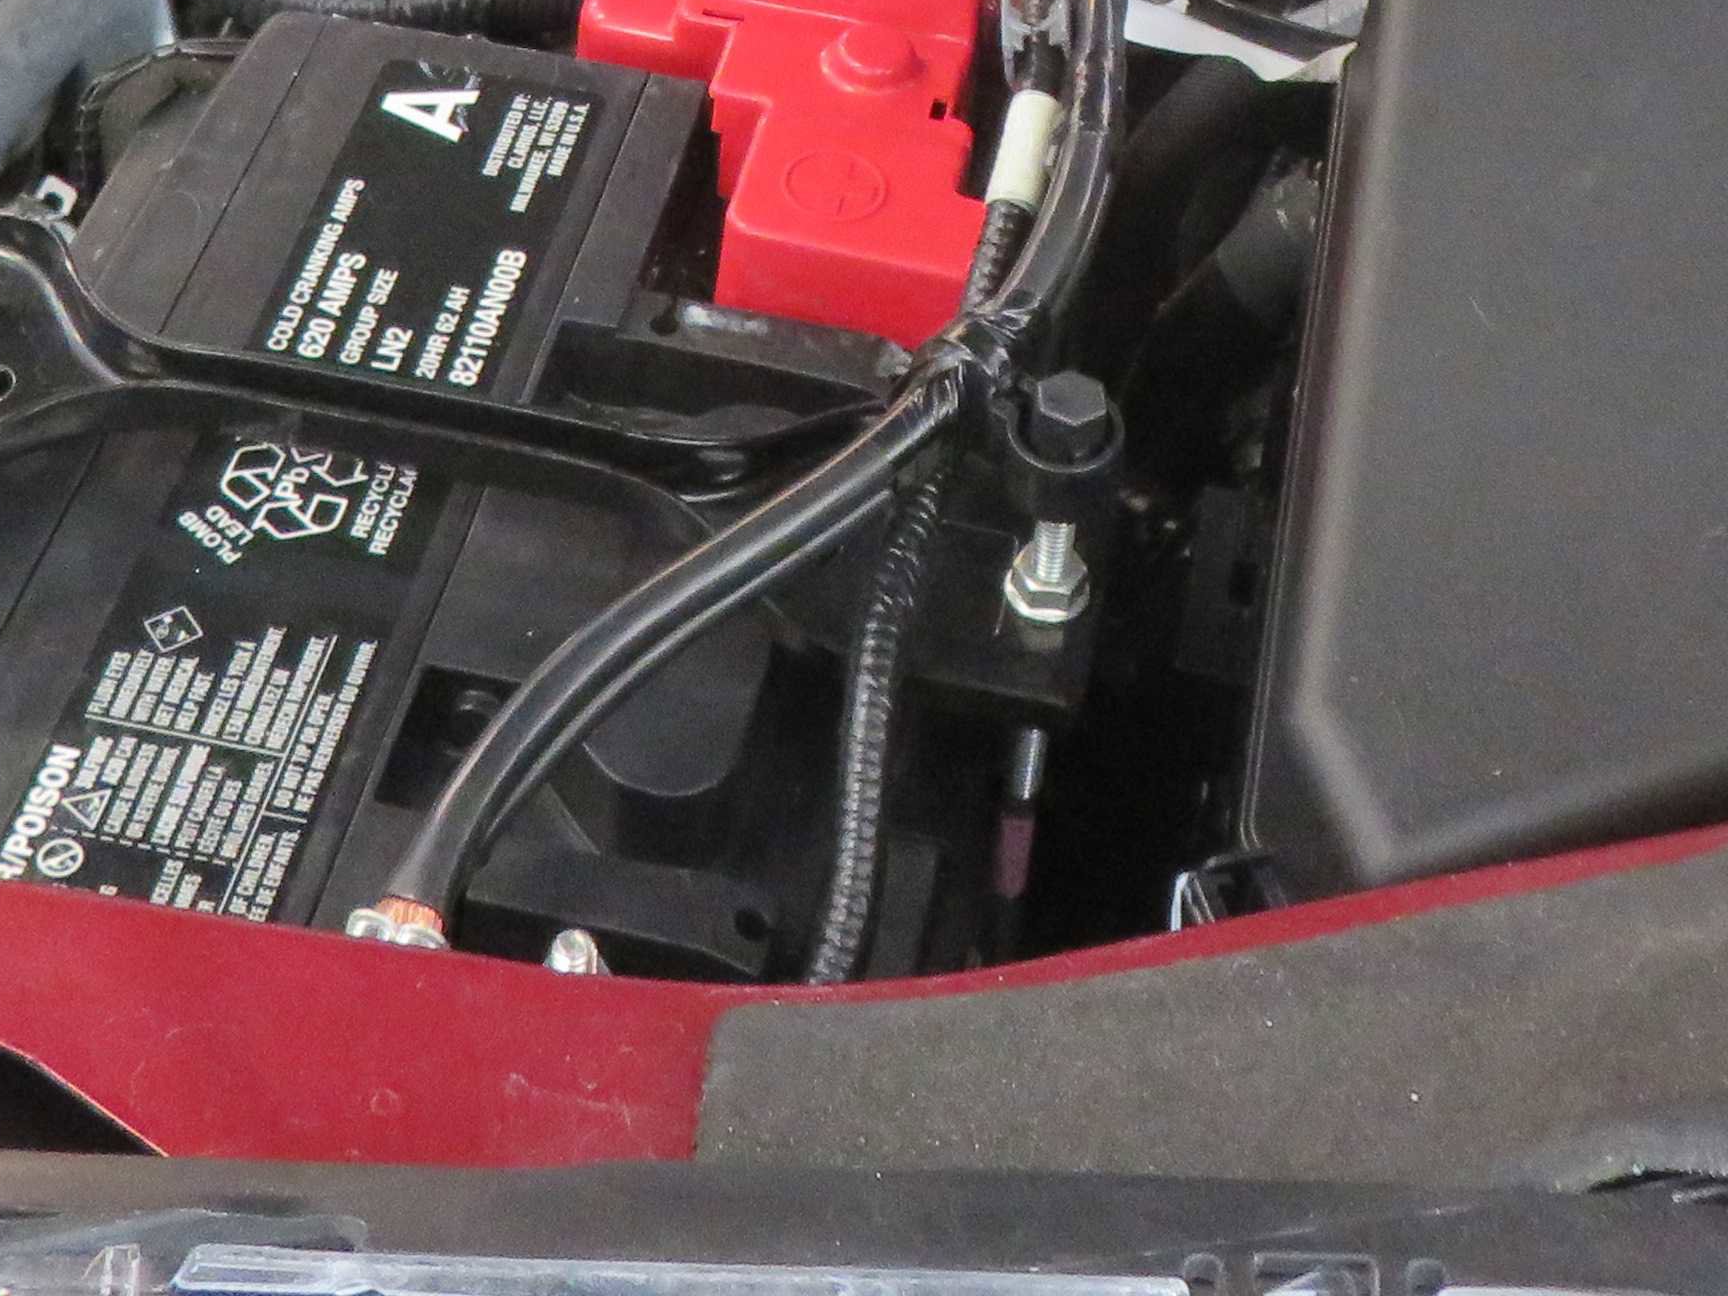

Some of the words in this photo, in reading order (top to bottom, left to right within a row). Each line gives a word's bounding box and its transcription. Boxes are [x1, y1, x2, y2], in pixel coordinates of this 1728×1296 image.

[380, 88, 482, 143] A
[563, 100, 591, 132] U.S.A.
[480, 110, 525, 176] DISTRIBUTED
[510, 92, 532, 110] BY:
[505, 119, 542, 168] CLARIOS,
[558, 131, 578, 145] IN
[508, 146, 551, 212] MILWAUKEE,
[537, 131, 557, 147] WI
[545, 145, 573, 176] MADE
[265, 304, 305, 351] COLD
[287, 221, 345, 305] CRANKING
[327, 177, 366, 222] AMPS
[314, 250, 369, 316] AMPS
[442, 285, 471, 311] AH
[337, 304, 383, 365] GROUP
[365, 268, 400, 305] SIZE
[433, 311, 461, 334] 62
[444, 247, 531, 387] 82110AN00B
[294, 316, 339, 359] 620
[369, 325, 415, 371] LN2
[413, 333, 452, 379] 20HR
[274, 466, 310, 500] Pb
[178, 511, 242, 565] PLOMB
[205, 505, 255, 545] LEAD
[226, 649, 253, 678] YEUX
[344, 638, 379, 685] OUVRIR.
[185, 670, 216, 701] FAST.
[216, 676, 242, 698] LES
[337, 683, 360, 703] OU
[150, 703, 177, 726] GET
[172, 701, 201, 730] HELP
[220, 709, 250, 740] L'EAU
[305, 690, 335, 726] OPEN.
[298, 726, 320, 744] OR
[309, 701, 354, 770] RENVERSER
[289, 743, 313, 764] TIP
[219, 778, 243, 800] DES
[279, 763, 305, 789] NOT
[300, 769, 325, 794] PAS
[131, 781, 165, 822] SEVERE
[173, 820, 201, 849] PEUT
[204, 763, 227, 780] LA
[271, 789, 295, 808] DO
[292, 793, 316, 812] NE
[234, 829, 278, 896] CHILDREN.
[260, 827, 302, 887] ENFANTS.
[228, 895, 250, 914] OF
[253, 886, 277, 905] DE
